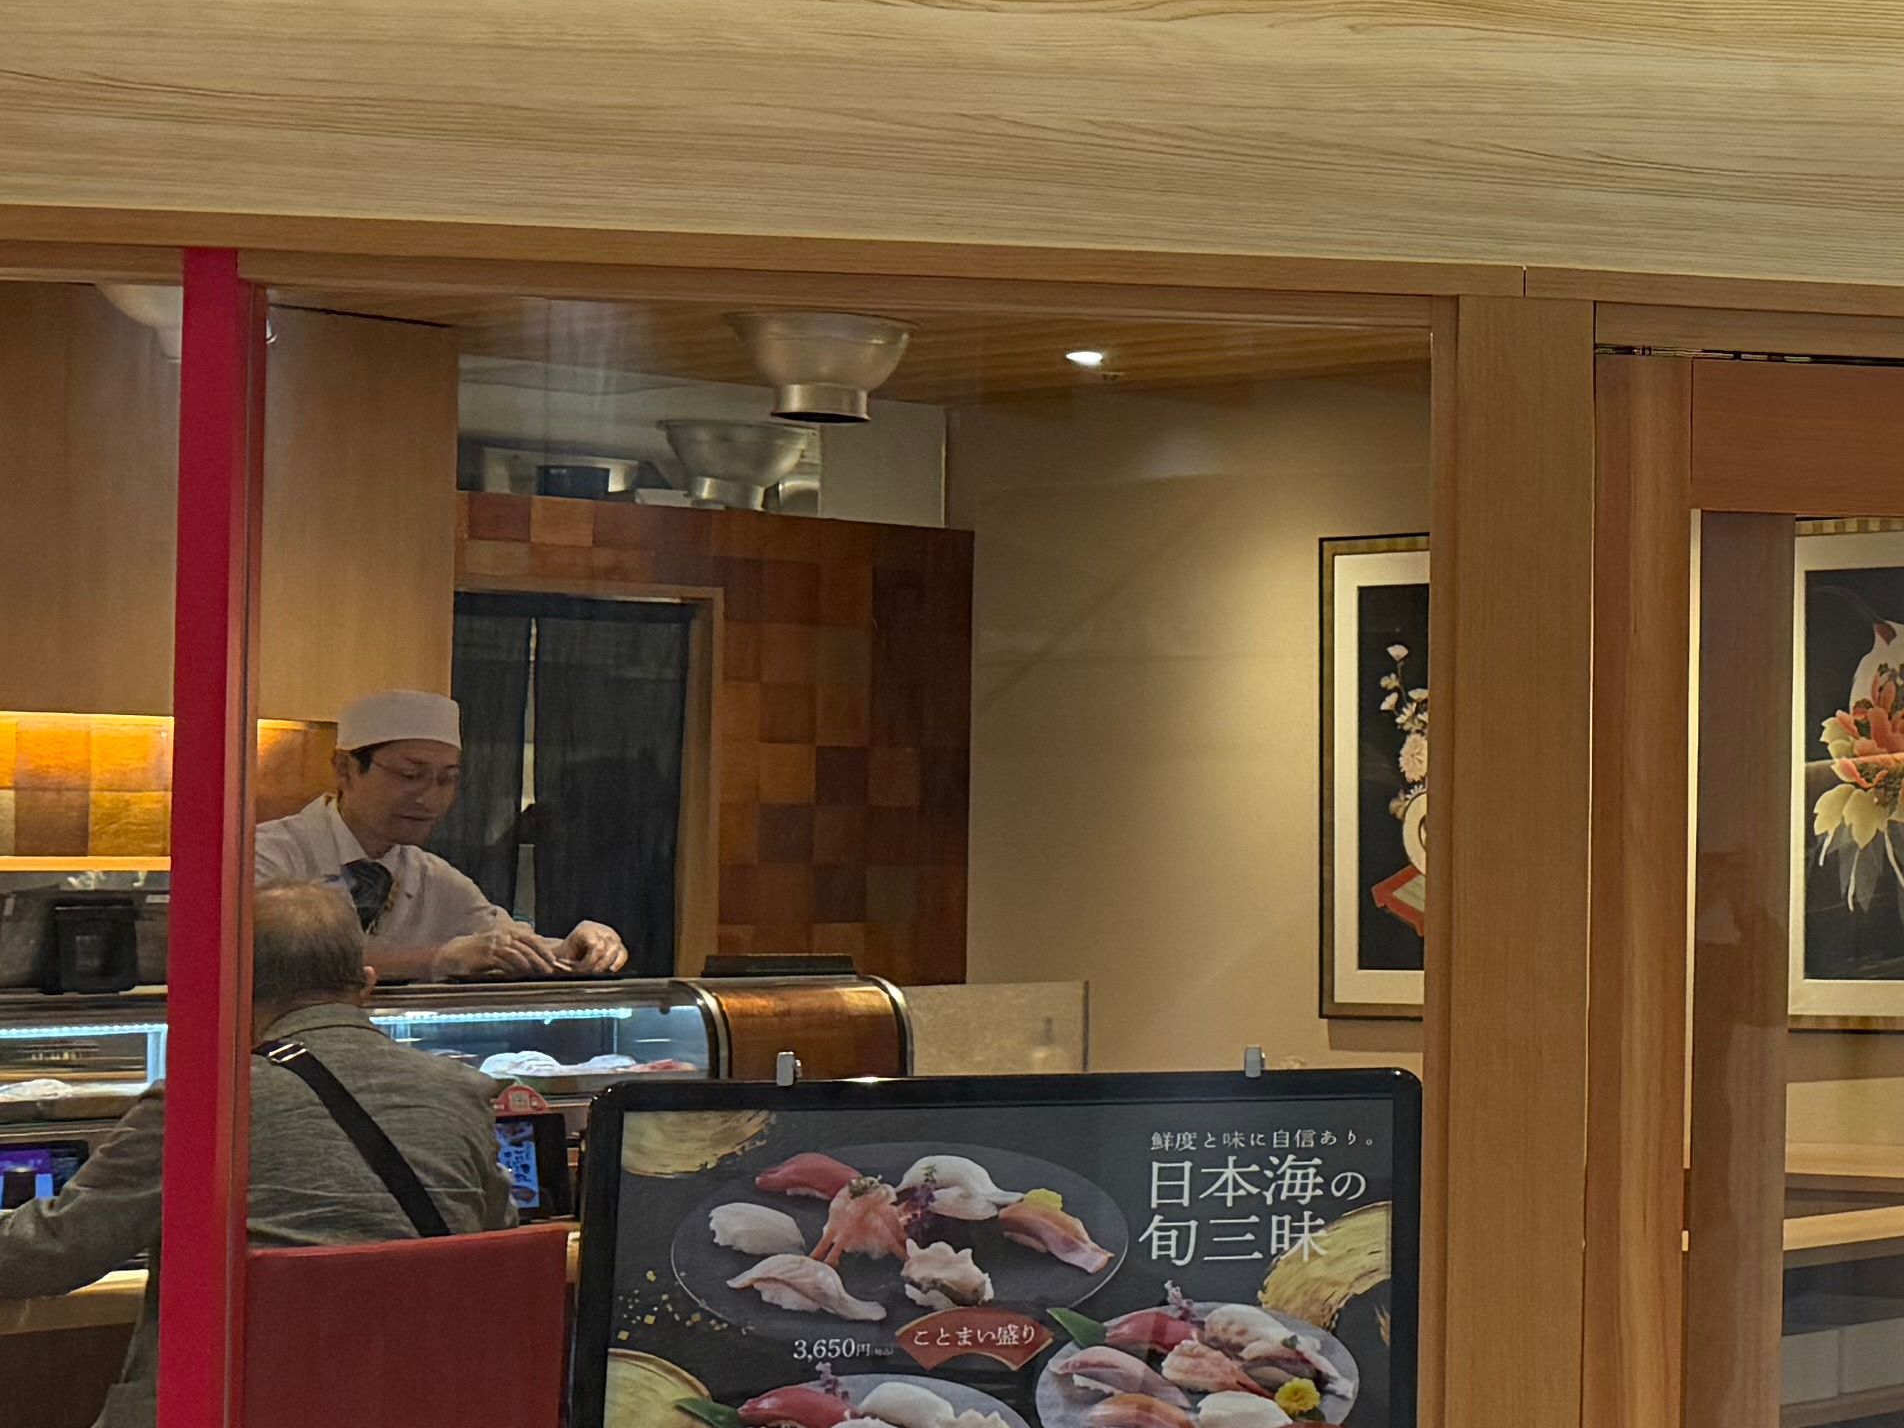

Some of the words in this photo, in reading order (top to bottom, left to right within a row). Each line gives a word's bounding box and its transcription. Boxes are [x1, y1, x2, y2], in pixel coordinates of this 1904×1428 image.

[1151, 1129, 1373, 1151] 鮮度と味に自信あり。
[1150, 1154, 1367, 1209] 日本海の
[1138, 1210, 1329, 1266] 旬三昧
[913, 1324, 1035, 1346] ことまい盛り
[793, 1338, 871, 1362] 3,650円
